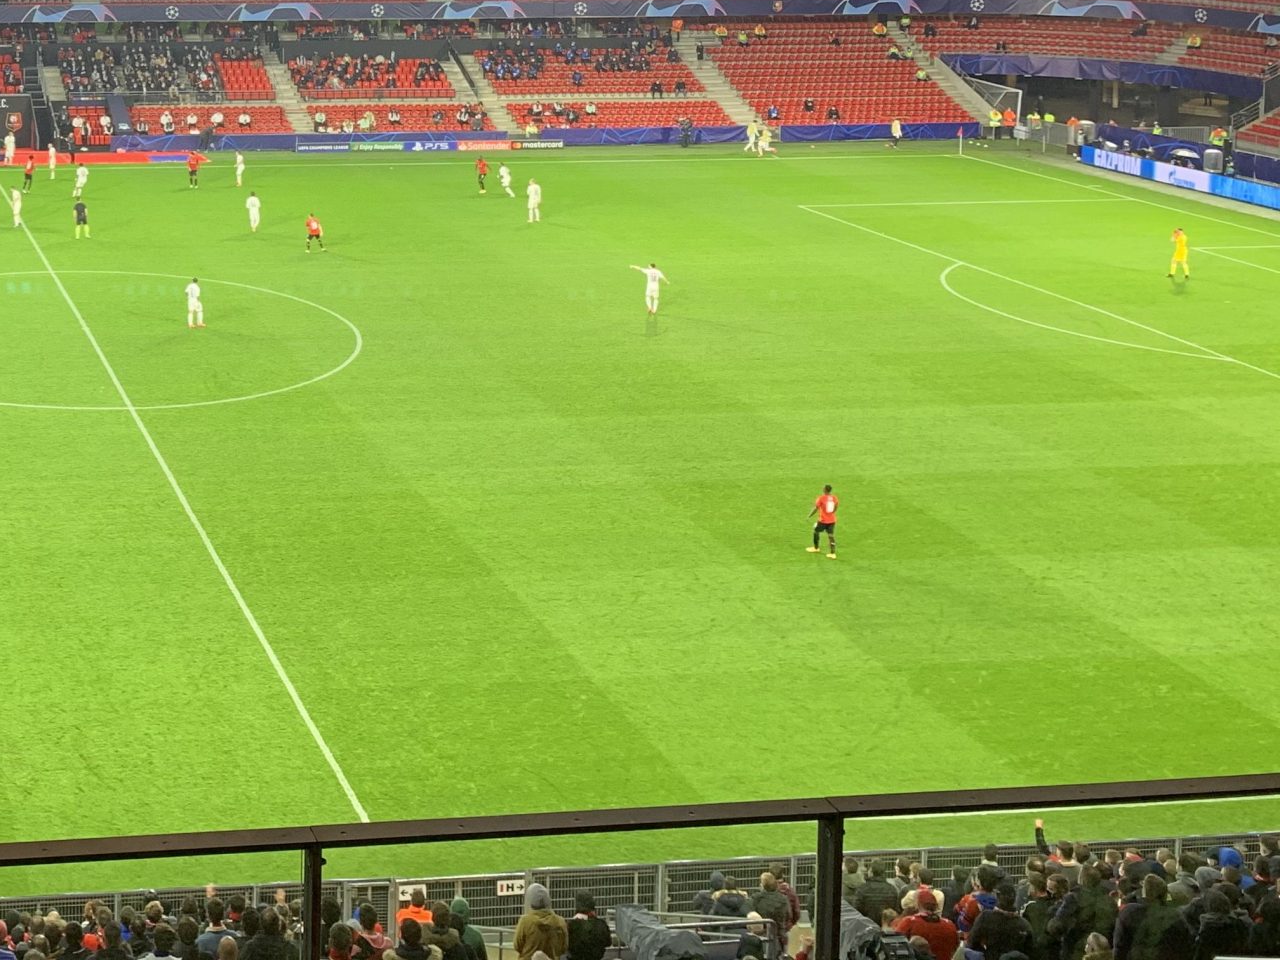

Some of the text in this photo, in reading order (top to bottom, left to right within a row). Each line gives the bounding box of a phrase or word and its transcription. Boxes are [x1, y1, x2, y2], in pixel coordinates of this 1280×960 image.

[424, 142, 449, 150] PS5
[468, 142, 510, 150] Santander
[522, 141, 563, 149] mastercard
[1094, 148, 1141, 176] GAZPROM
[506, 883, 515, 892] H
